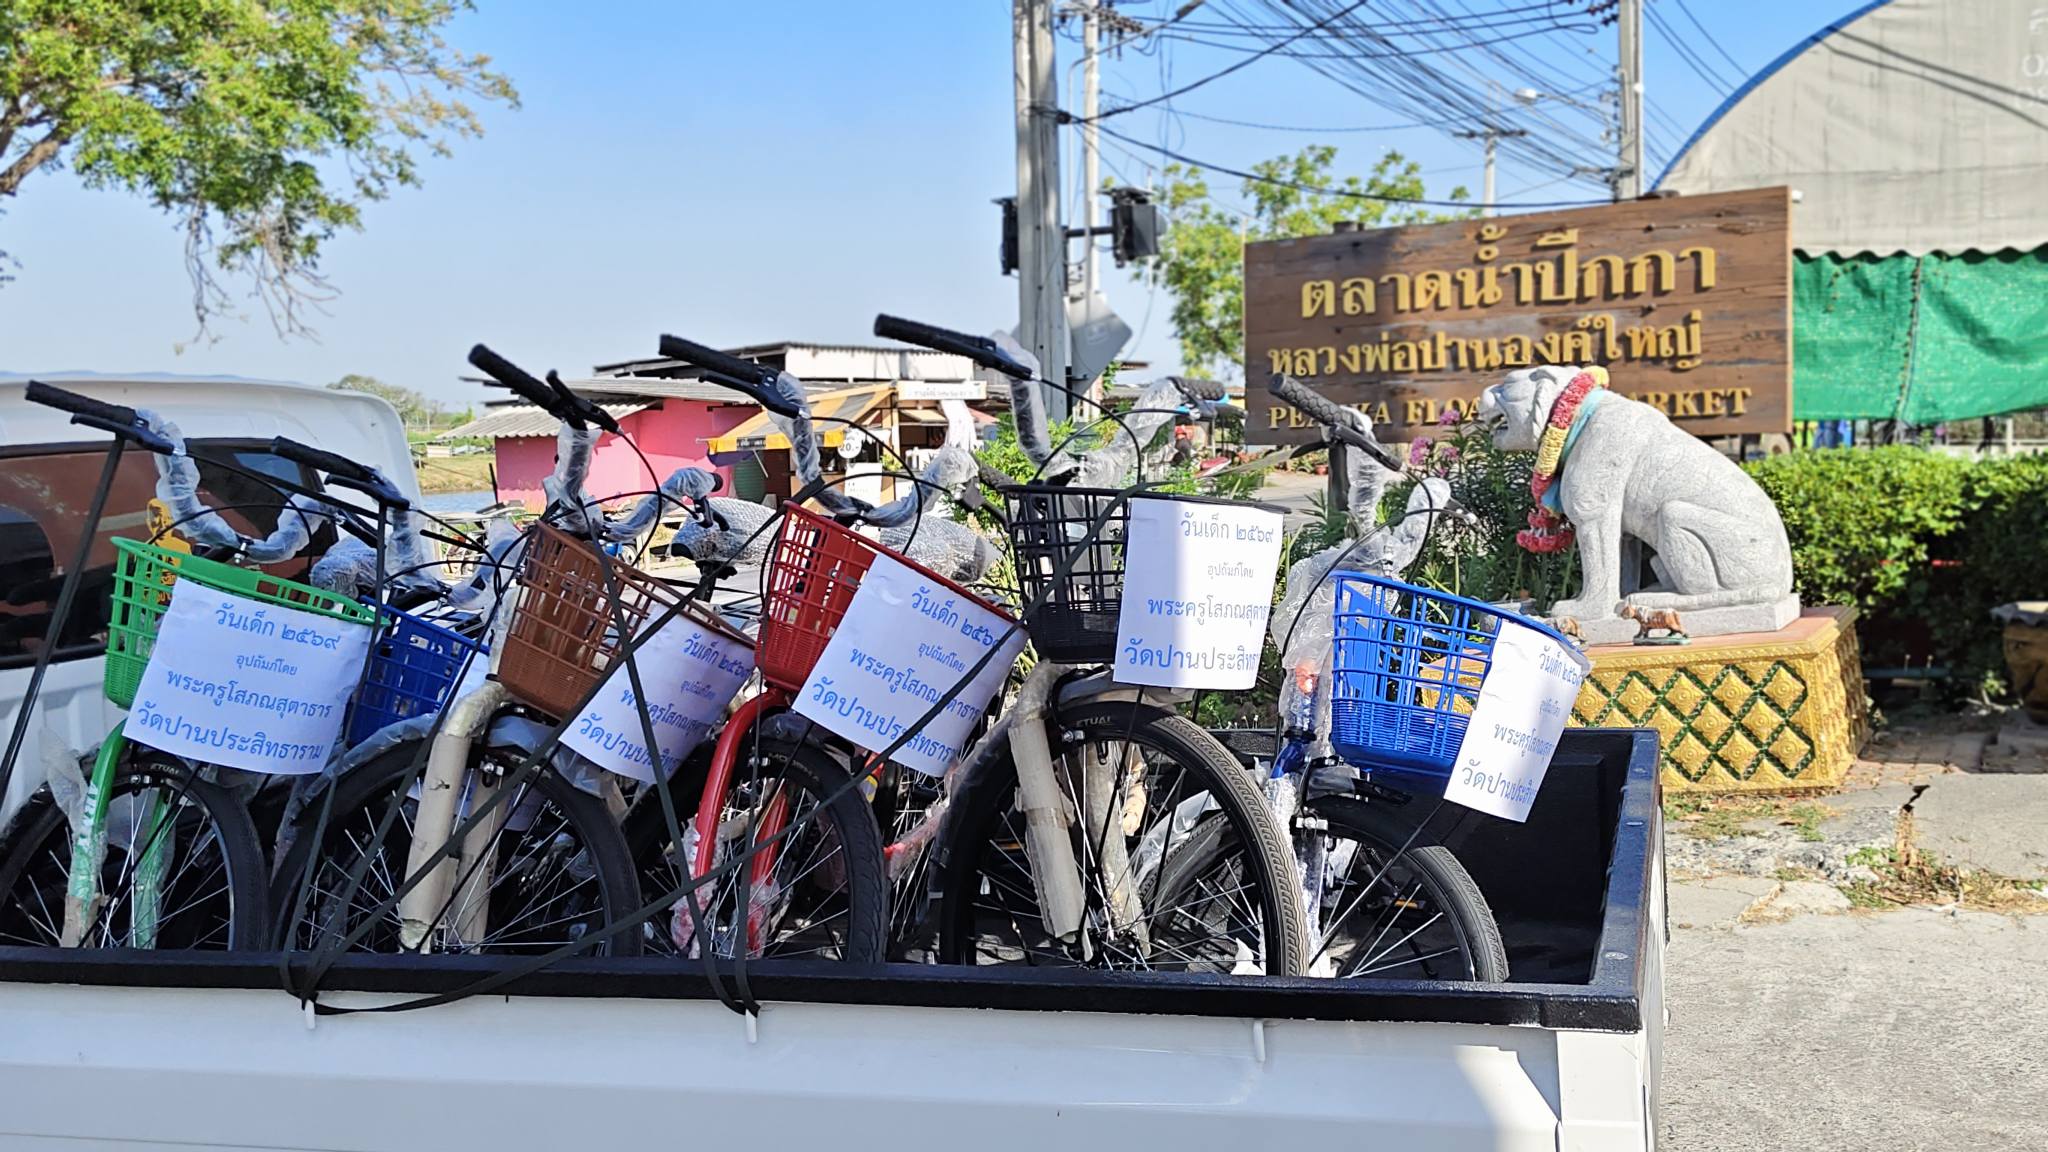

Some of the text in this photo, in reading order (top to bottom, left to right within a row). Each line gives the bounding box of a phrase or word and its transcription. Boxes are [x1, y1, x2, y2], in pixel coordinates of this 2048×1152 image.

[1301, 223, 1716, 318] ตลาดน้ำปีกกา
[1629, 387, 1752, 417] RKET
[1181, 511, 1274, 544] วันเด็ก ๒๕๖๙
[215, 602, 341, 650] วันเด็ก ๒๕๖๙
[912, 586, 958, 629] วันเด็ก
[236, 653, 298, 676] อุปถัมภ์โดย
[684, 632, 719, 665] วันเด็ก
[167, 670, 333, 720] พระครูโสภณสุตาธาร
[137, 701, 324, 760] วัดปานประสิทธาราม
